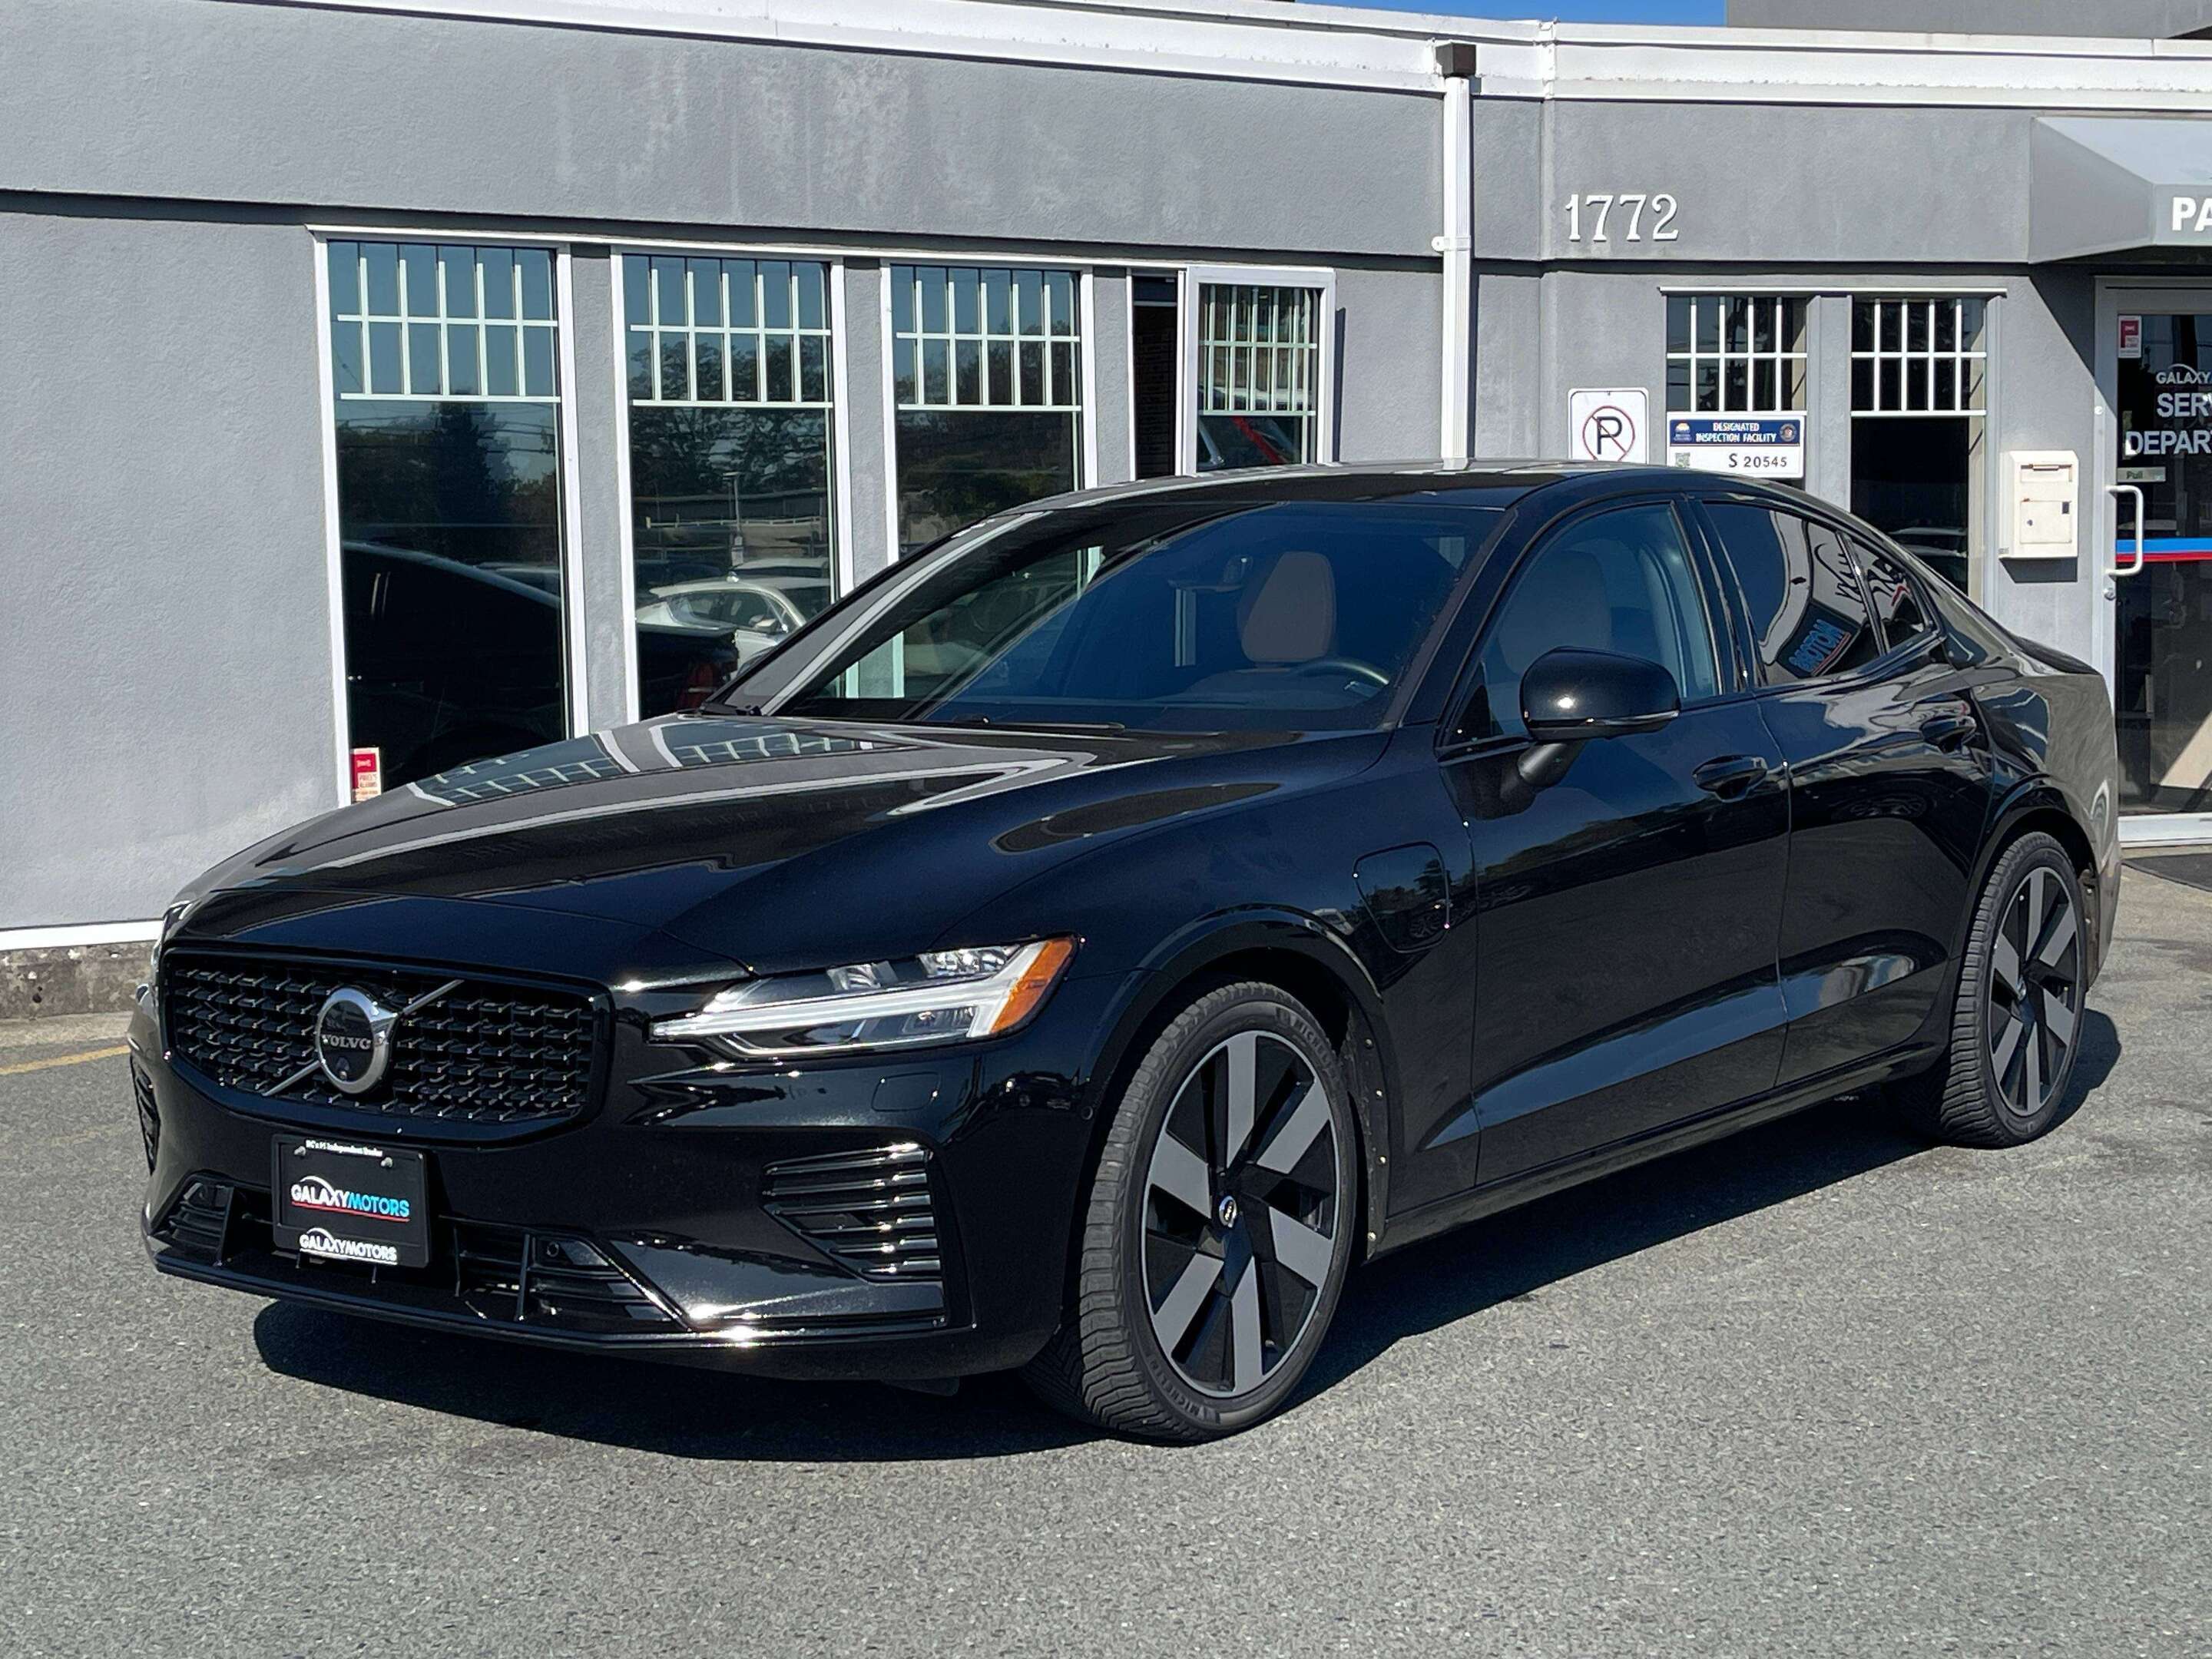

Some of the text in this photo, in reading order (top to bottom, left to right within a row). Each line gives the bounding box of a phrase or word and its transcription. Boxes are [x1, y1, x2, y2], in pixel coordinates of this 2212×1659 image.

[1565, 194, 1679, 241] 1772
[2156, 364, 2212, 384] GALAXY
[2157, 392, 2212, 417] SER
[1597, 416, 1622, 455] P
[1713, 422, 1760, 432] DESIGNATED
[1696, 433, 1740, 442] INSPECTION
[1743, 433, 1777, 442] FACILITY
[2125, 430, 2212, 455] DEPAR
[1729, 453, 1787, 468] S 20545
[322, 1034, 371, 1051] VOLVO
